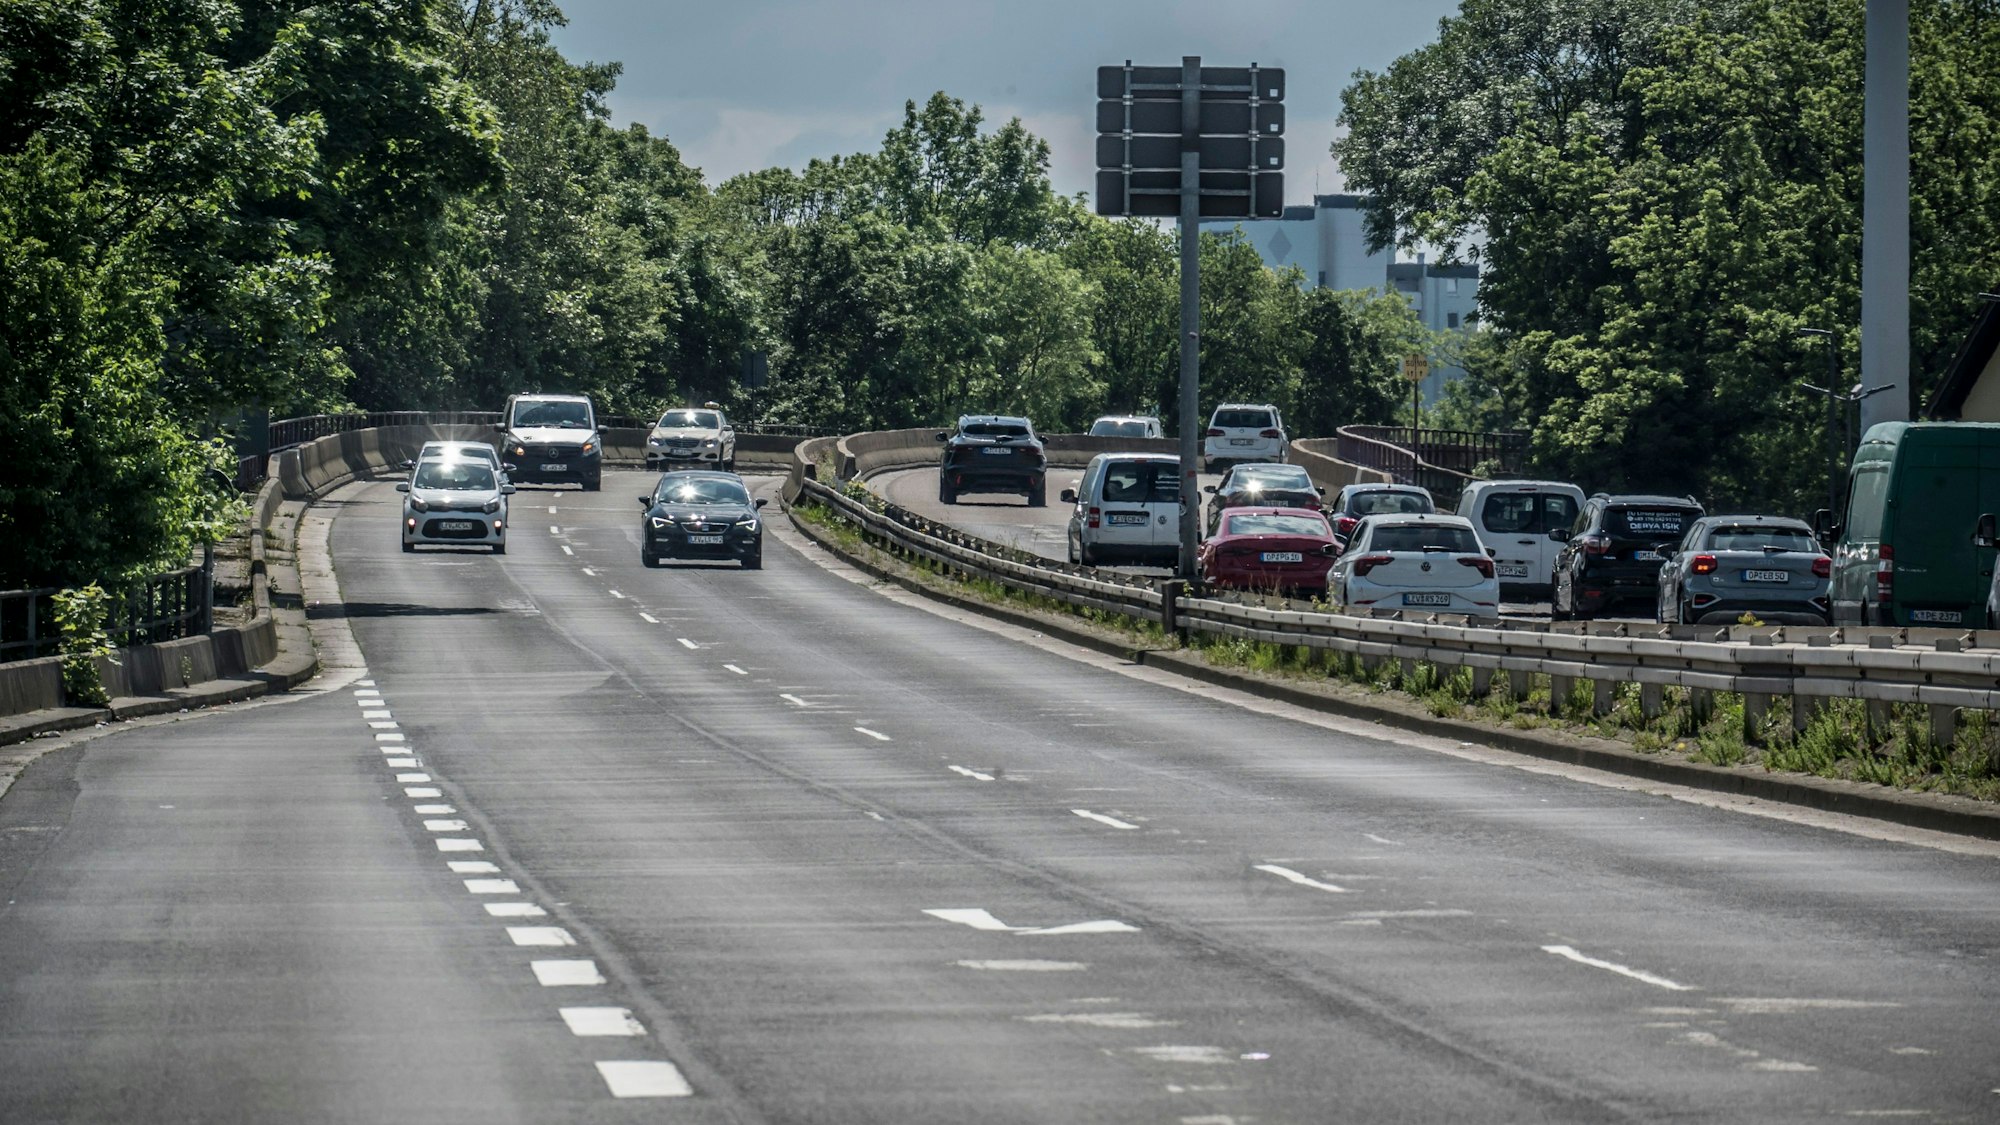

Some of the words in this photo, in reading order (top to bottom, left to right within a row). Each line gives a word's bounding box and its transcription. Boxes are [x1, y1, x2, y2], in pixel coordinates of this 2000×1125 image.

[1629, 522, 1660, 530] DERYA
[1662, 522, 1680, 530] ISIK
[1266, 553, 1276, 561] OP
[1280, 553, 1290, 561] PG
[1290, 553, 1300, 561] 10
[1748, 571, 1759, 579] OP
[1763, 571, 1774, 580] EB
[1775, 572, 1785, 580] 50
[1407, 595, 1421, 603] LEV
[1425, 595, 1435, 603] RS
[1435, 595, 1448, 603] 269
[1914, 611, 1920, 620] K
[1926, 611, 1938, 621] PE
[1938, 612, 1960, 622] 2371
